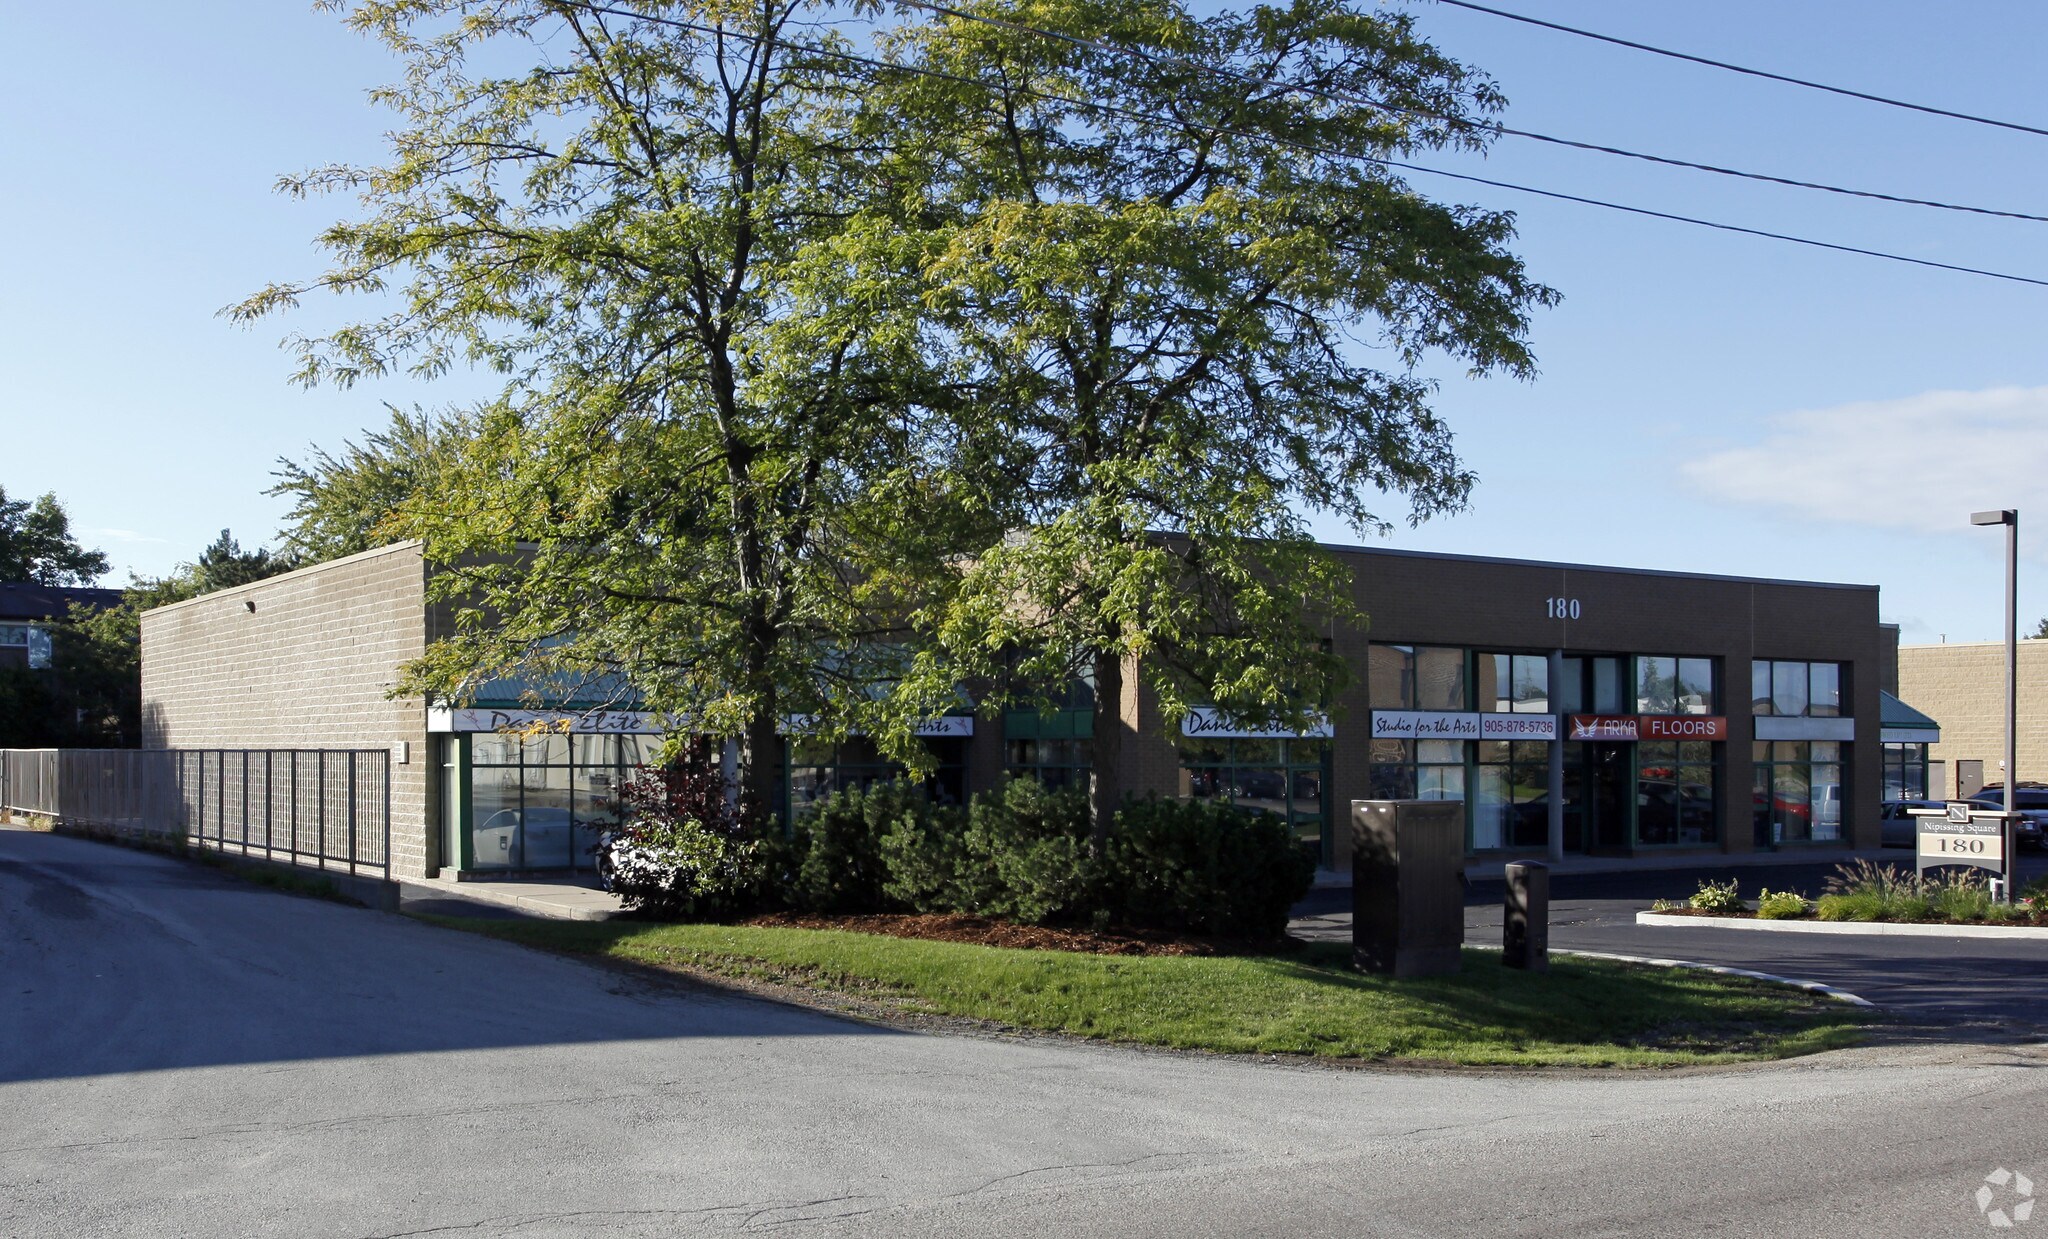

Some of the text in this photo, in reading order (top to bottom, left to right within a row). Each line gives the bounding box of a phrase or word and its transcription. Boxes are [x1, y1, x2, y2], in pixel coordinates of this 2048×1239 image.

[1545, 597, 1580, 620] 180
[915, 719, 951, 734] Arts
[1376, 717, 1478, 738] Studio for the Arts
[1484, 719, 1554, 733] 905-878-5736
[1604, 719, 1716, 736] ARKA FLOORS
[1951, 807, 1965, 820] N
[1924, 822, 1997, 835] Nipissing Square
[1937, 838, 1985, 854] 180
